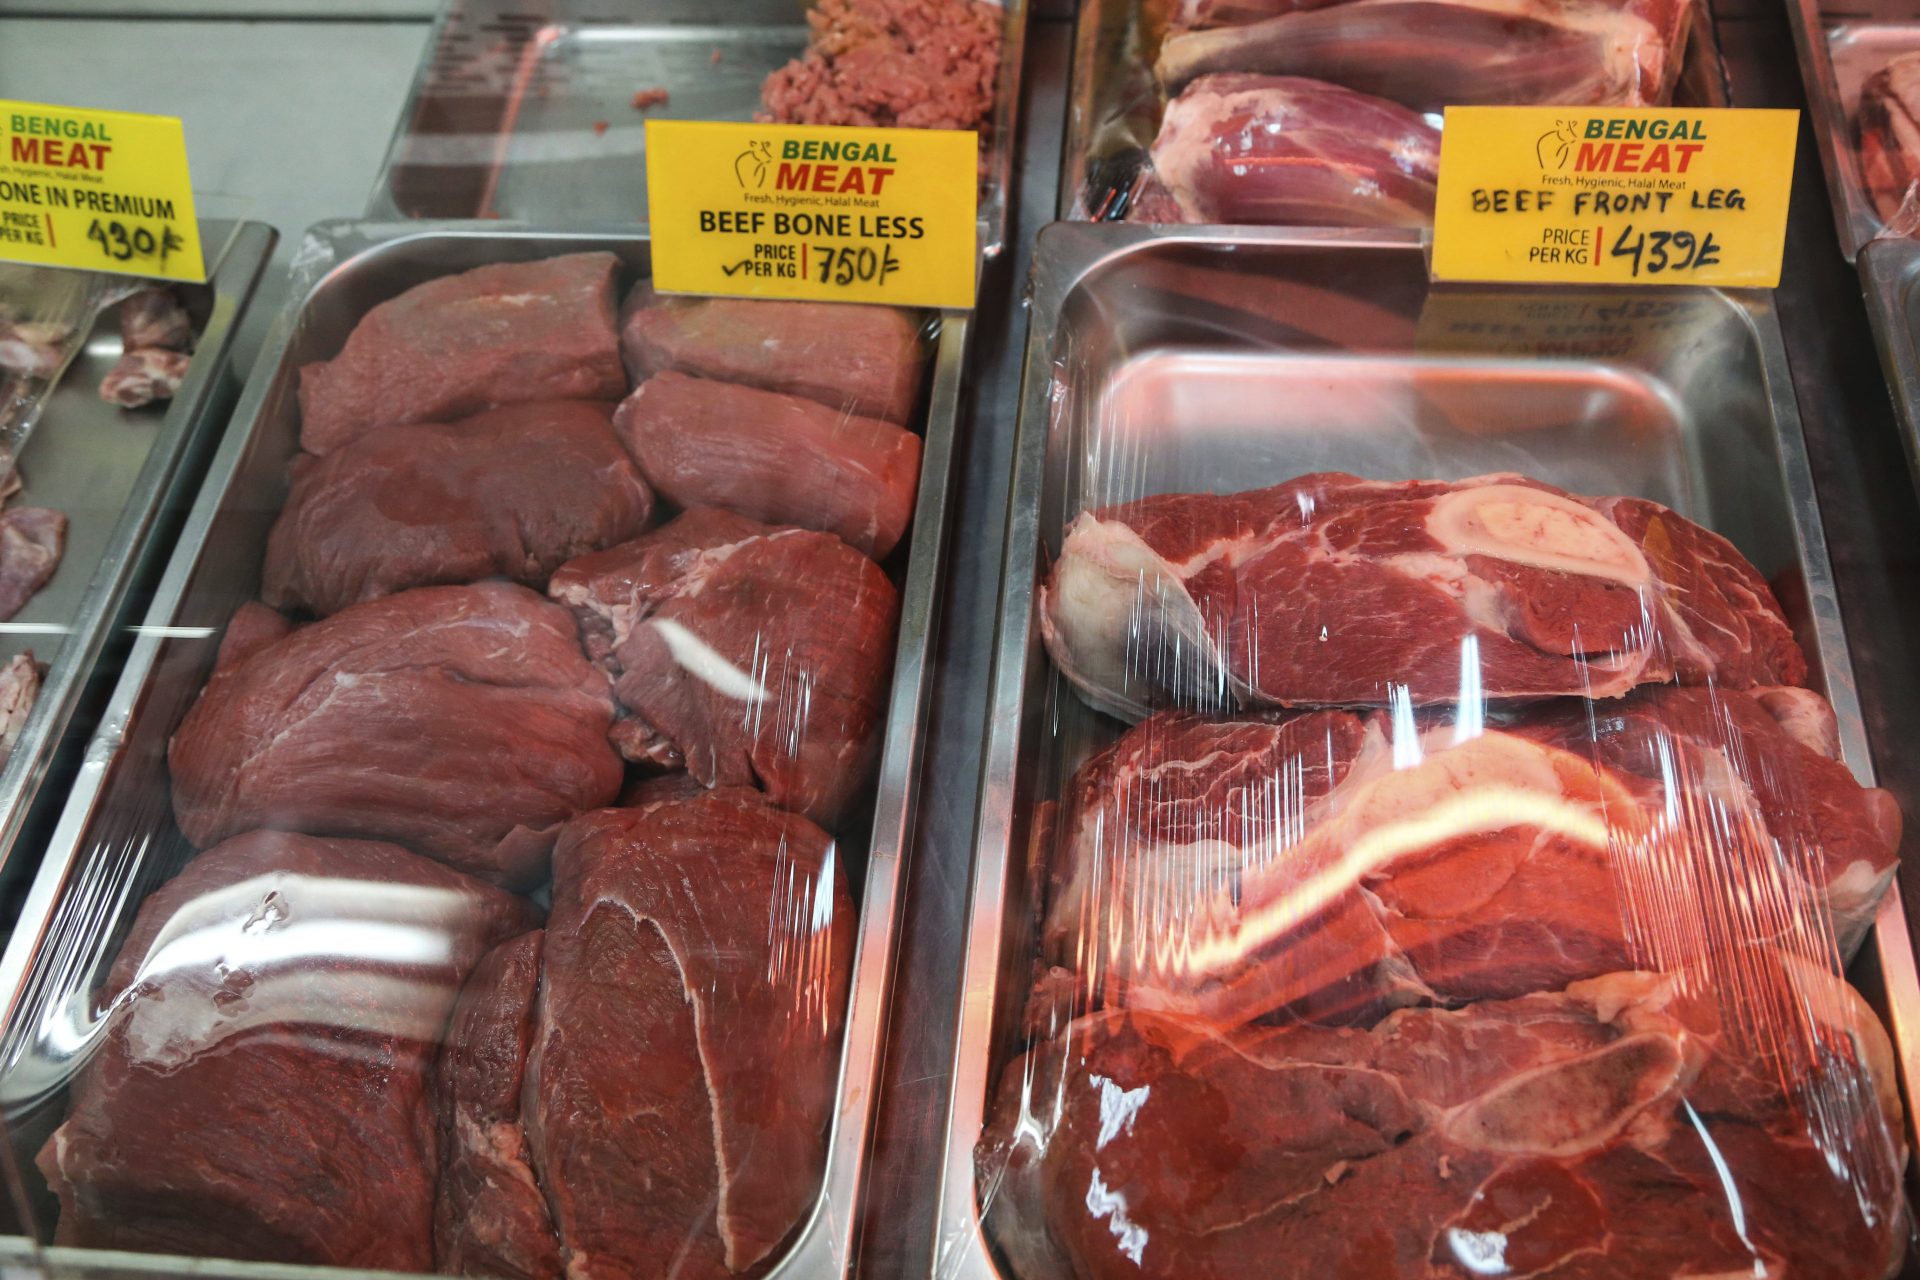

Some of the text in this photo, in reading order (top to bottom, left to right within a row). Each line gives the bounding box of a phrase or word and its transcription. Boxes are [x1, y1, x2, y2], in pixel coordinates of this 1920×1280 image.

[11, 114, 112, 141] BENGAL
[1584, 119, 1707, 141] BENGAL
[11, 136, 112, 171] MEAT
[782, 140, 897, 163] BENGAL
[1574, 143, 1704, 174] MEAT
[775, 163, 894, 195] MEAT
[1542, 174, 1686, 190] Fresh, Hygienic, Halal Meat
[45, 185, 69, 208] IN
[73, 188, 176, 220] PREMIUM
[744, 193, 880, 208] Fresh, Hygienic, Halal Meat
[1471, 188, 1746, 215] BEEF FRONT LEG
[2, 211, 40, 229] PRICE
[700, 211, 924, 239] BEEF BONE LESS
[25, 230, 44, 245] KG
[1543, 228, 1590, 246] PRICE
[754, 243, 796, 260] PRICE
[1529, 247, 1588, 265] PER KG
[744, 260, 796, 278] PER KG
